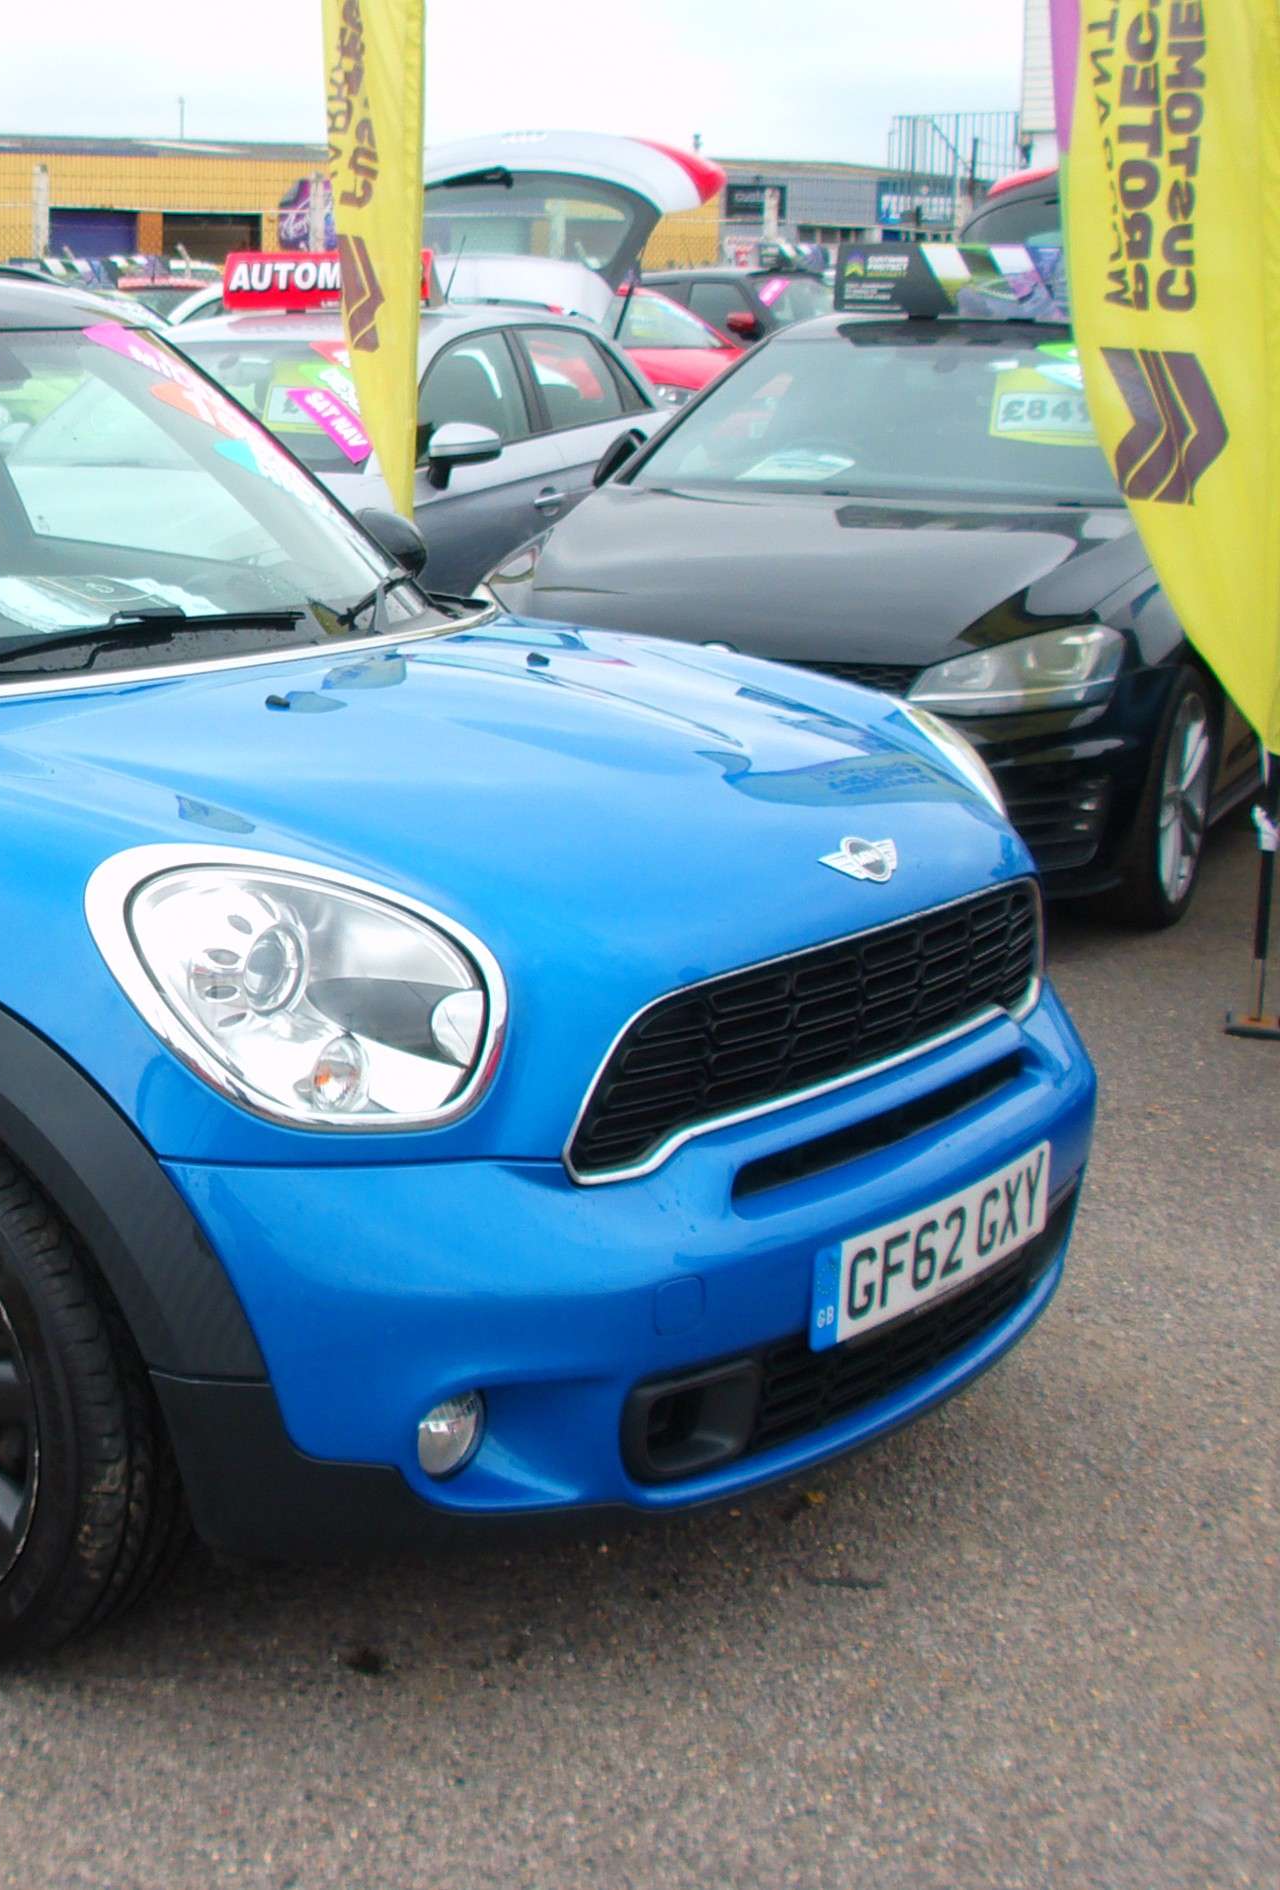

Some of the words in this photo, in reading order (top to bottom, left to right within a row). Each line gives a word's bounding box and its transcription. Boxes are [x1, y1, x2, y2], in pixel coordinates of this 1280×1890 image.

[229, 262, 342, 291] AUTOM
[304, 391, 341, 418] SAT
[330, 415, 369, 447] NAV
[847, 1206, 966, 1321] GF62
[975, 1150, 1046, 1257] GXY
[816, 1305, 835, 1328] GB
